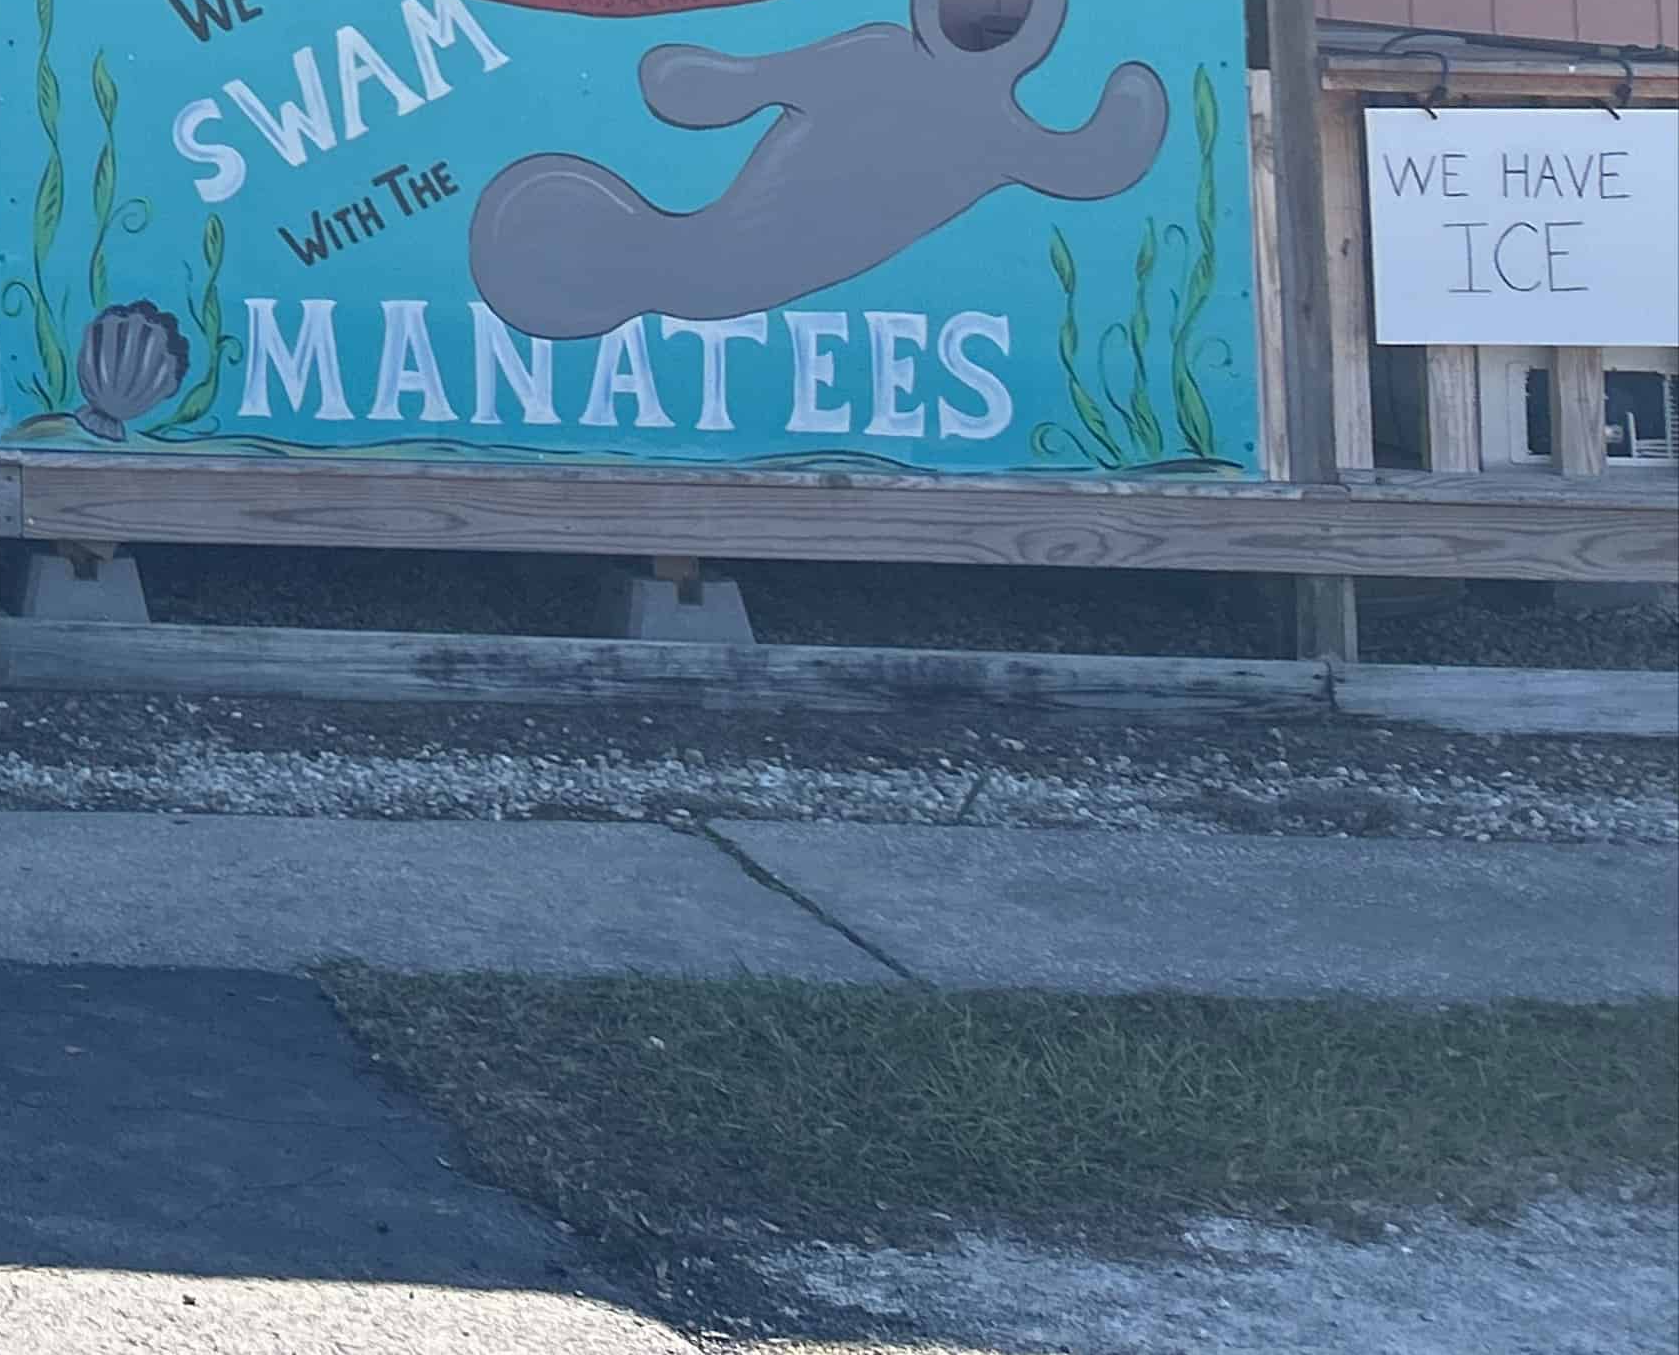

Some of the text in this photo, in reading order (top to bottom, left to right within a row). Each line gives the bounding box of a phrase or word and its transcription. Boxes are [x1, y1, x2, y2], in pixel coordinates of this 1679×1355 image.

[276, 161, 461, 267] WITH THE
[1383, 150, 1633, 200] WE HAVE
[1442, 219, 1590, 295] ICE
[239, 298, 1015, 440] MANATEES
